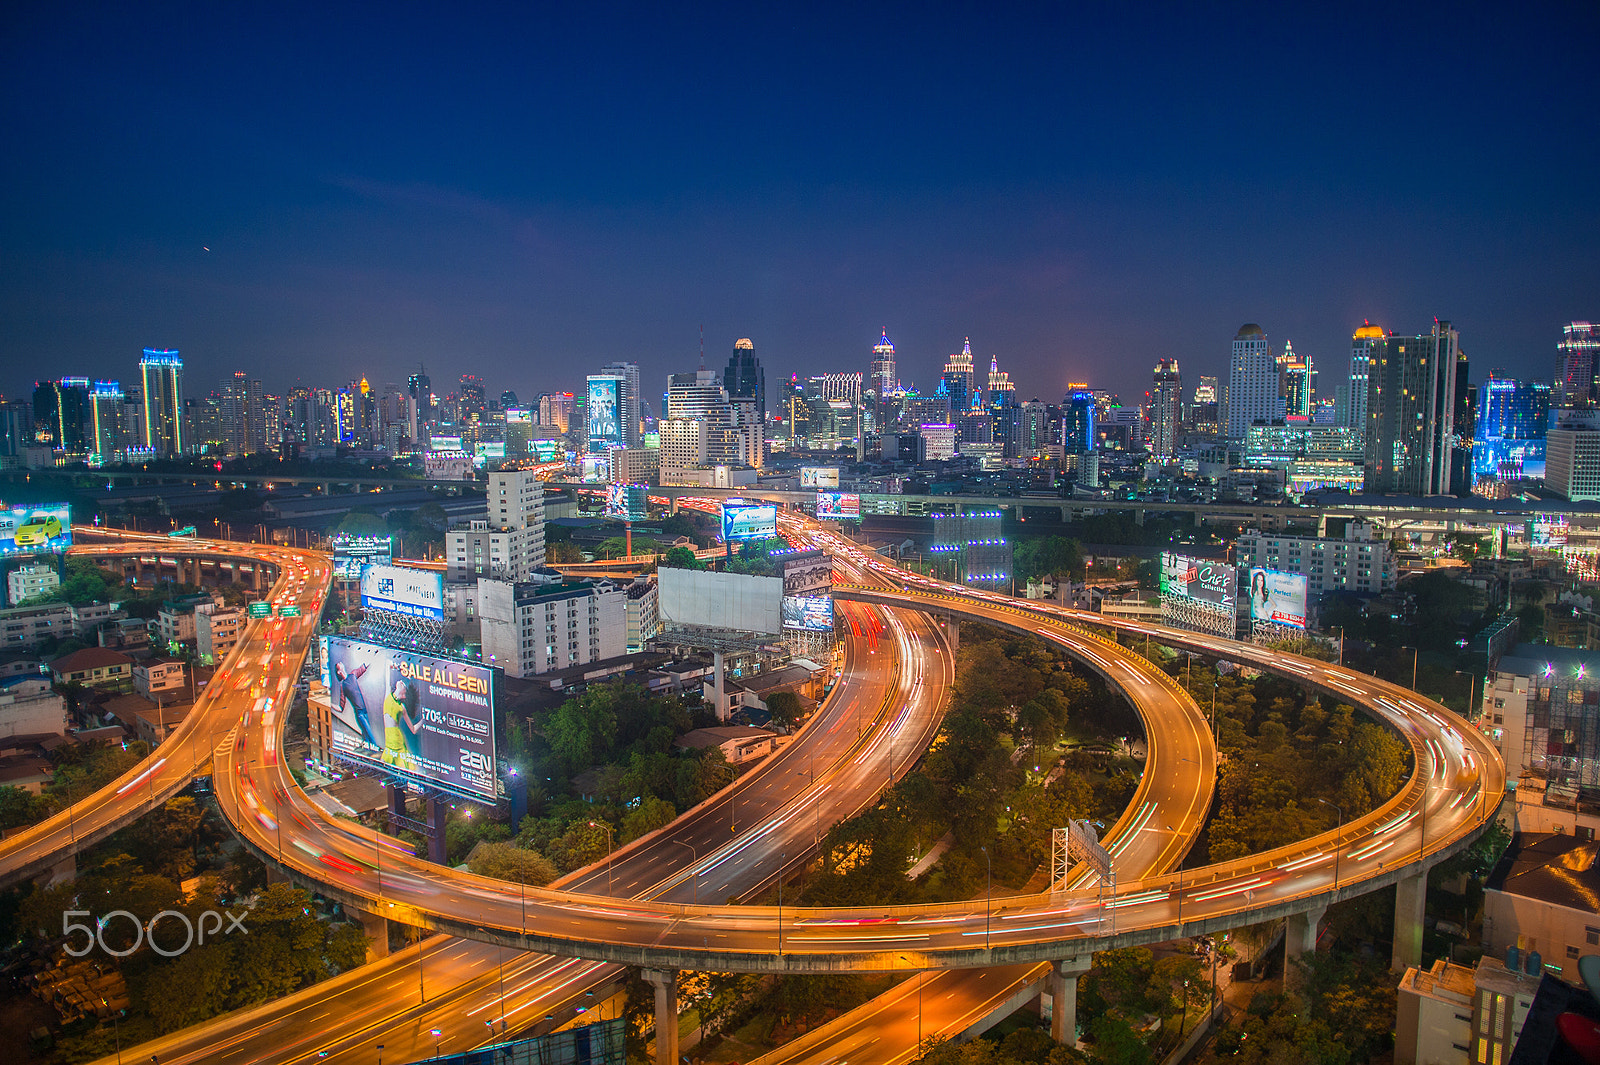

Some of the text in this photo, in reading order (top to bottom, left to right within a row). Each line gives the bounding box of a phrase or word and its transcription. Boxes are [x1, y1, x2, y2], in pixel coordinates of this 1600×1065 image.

[400, 661, 488, 695] SALE ALL ZEN
[429, 685, 488, 707] SHOPPING MANIA
[459, 747, 491, 772] ZEN
